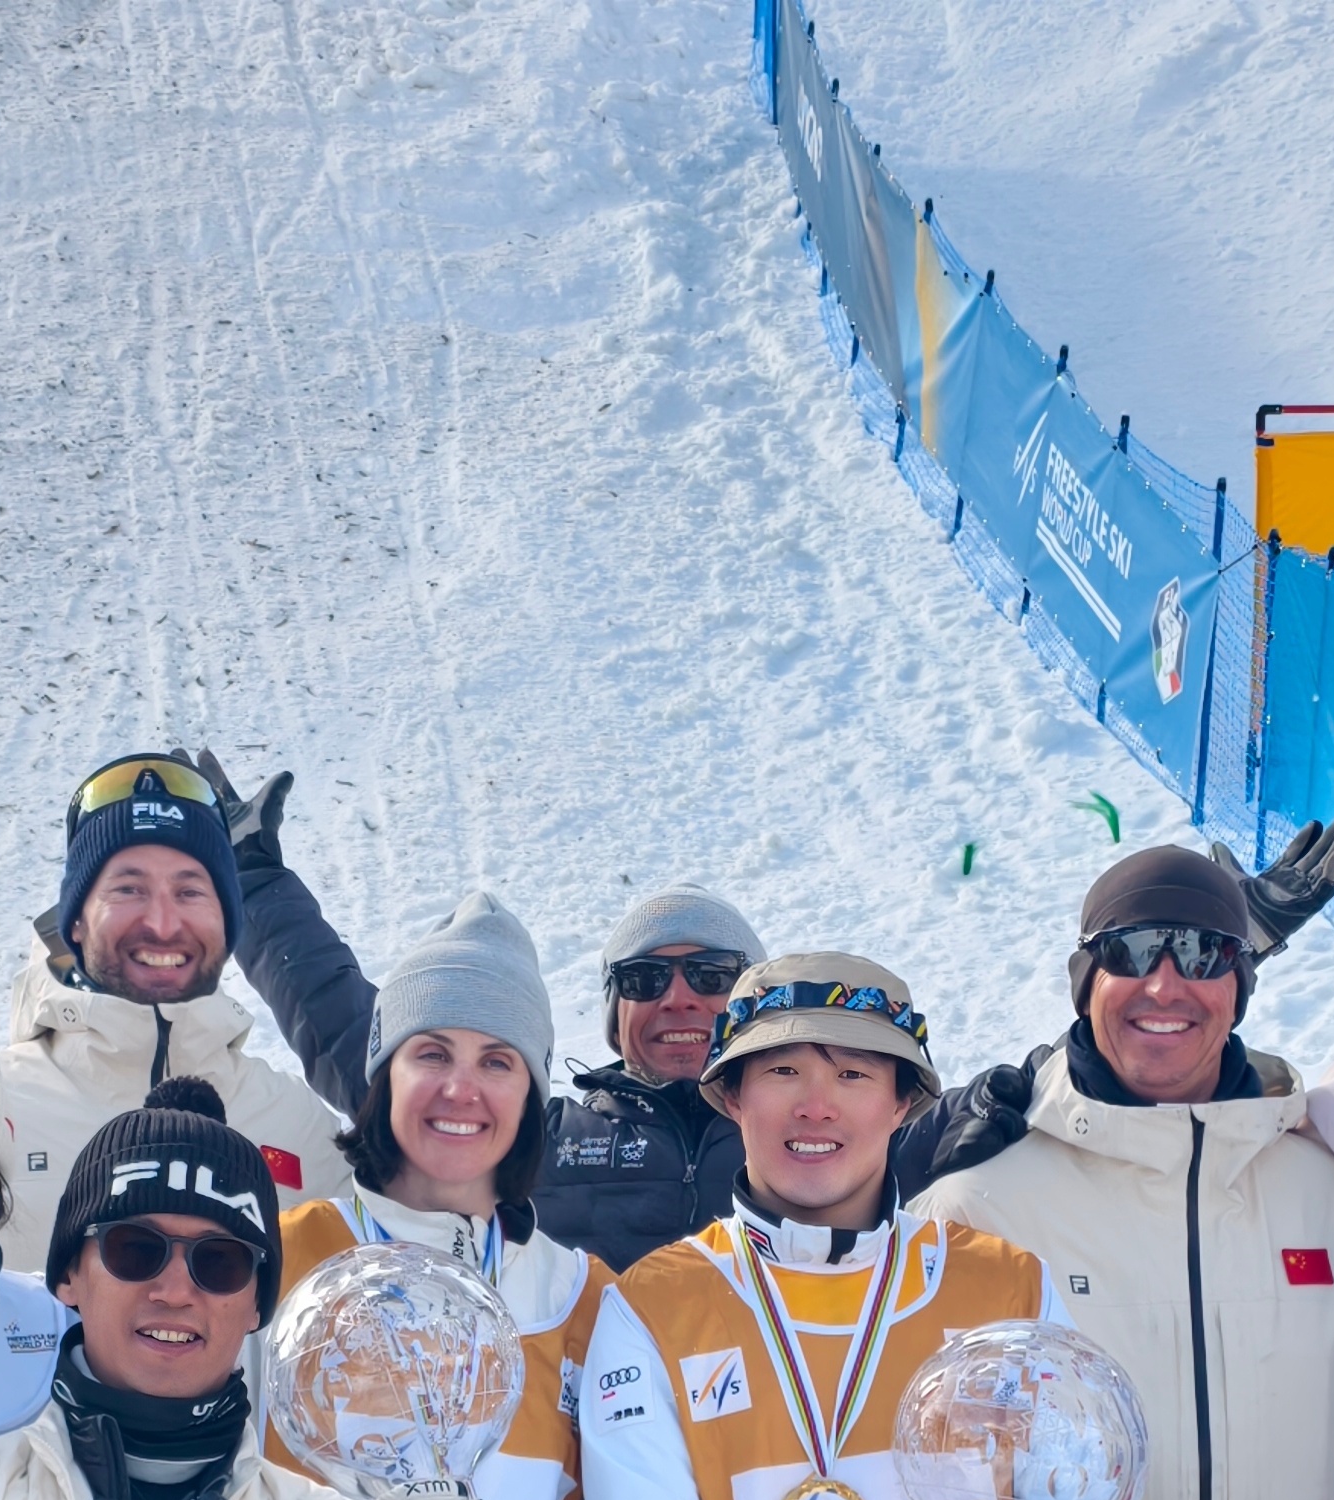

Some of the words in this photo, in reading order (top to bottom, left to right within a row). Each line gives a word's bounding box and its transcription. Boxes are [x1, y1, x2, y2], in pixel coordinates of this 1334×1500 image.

[1041, 482, 1074, 545] WORLD
[1071, 526, 1093, 570] CUP
[1045, 442, 1109, 552] FREESTYLE
[1107, 524, 1133, 580] SKI
[132, 802, 185, 821] FILA
[110, 1160, 267, 1235] FILA
[691, 1379, 742, 1404] FIS
